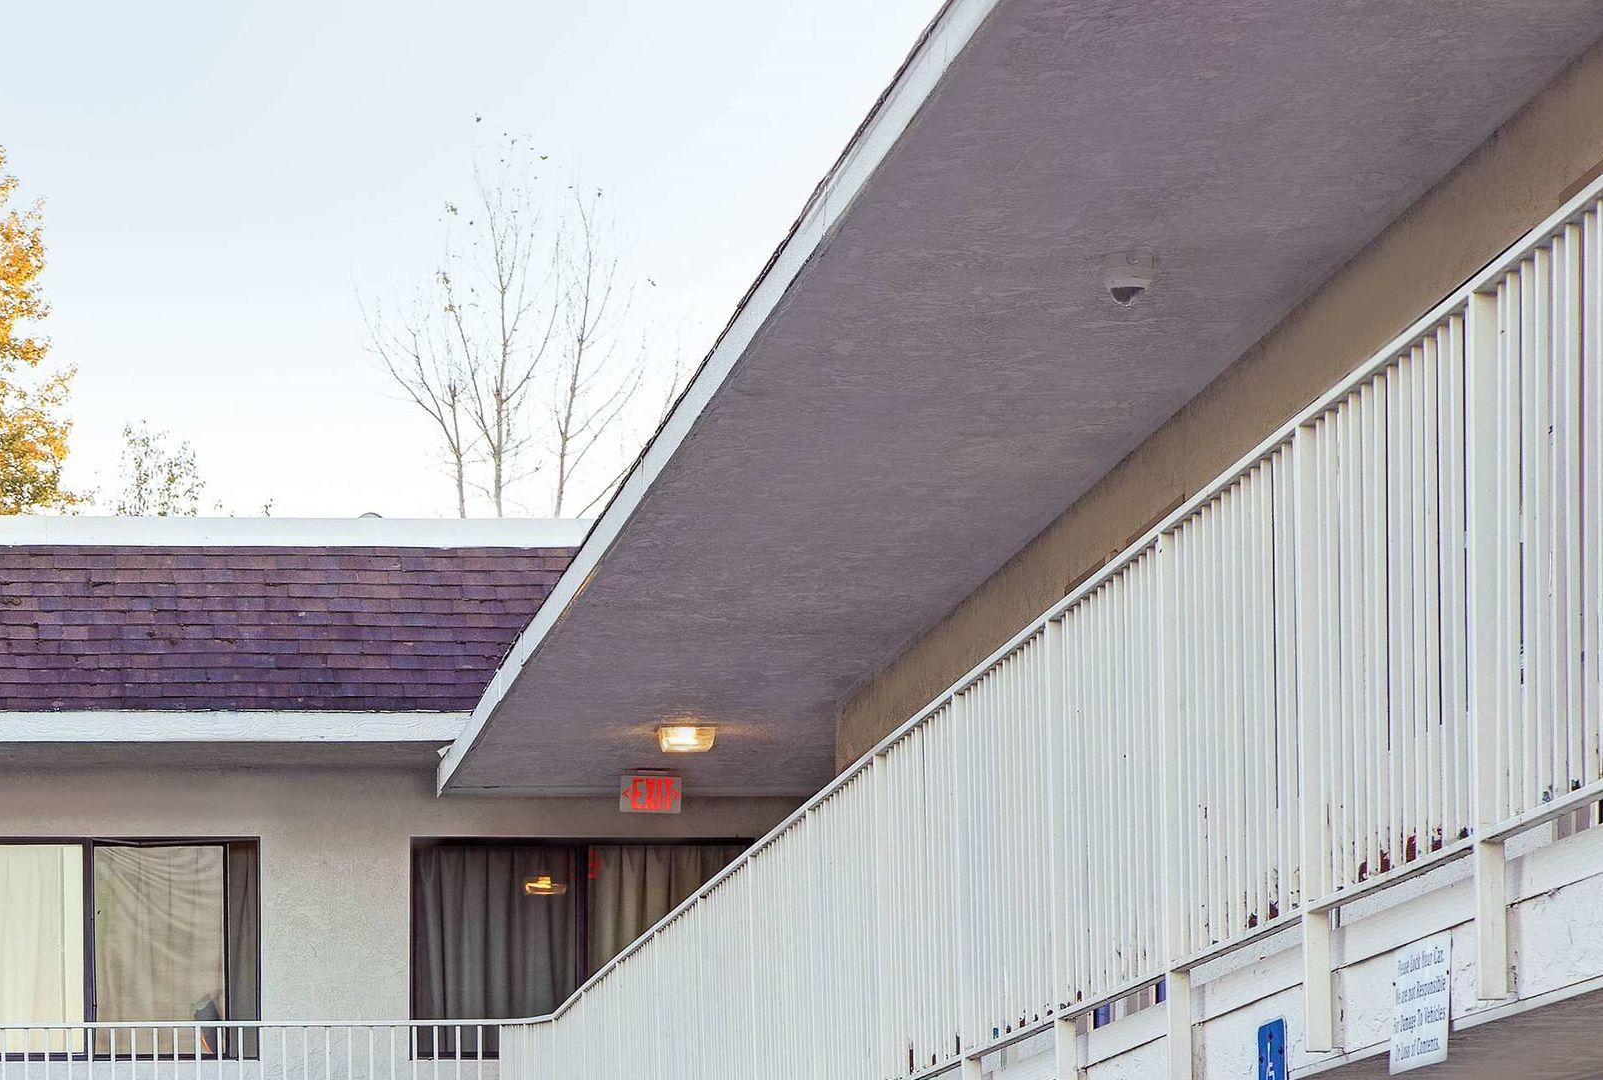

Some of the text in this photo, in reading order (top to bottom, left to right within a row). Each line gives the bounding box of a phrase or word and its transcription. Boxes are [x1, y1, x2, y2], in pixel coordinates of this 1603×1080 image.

[631, 776, 674, 812] EXIT
[1416, 975, 1446, 1001] Responsible
[1400, 1014, 1416, 1034] Damage
[1424, 1004, 1446, 1024] Vehicles
